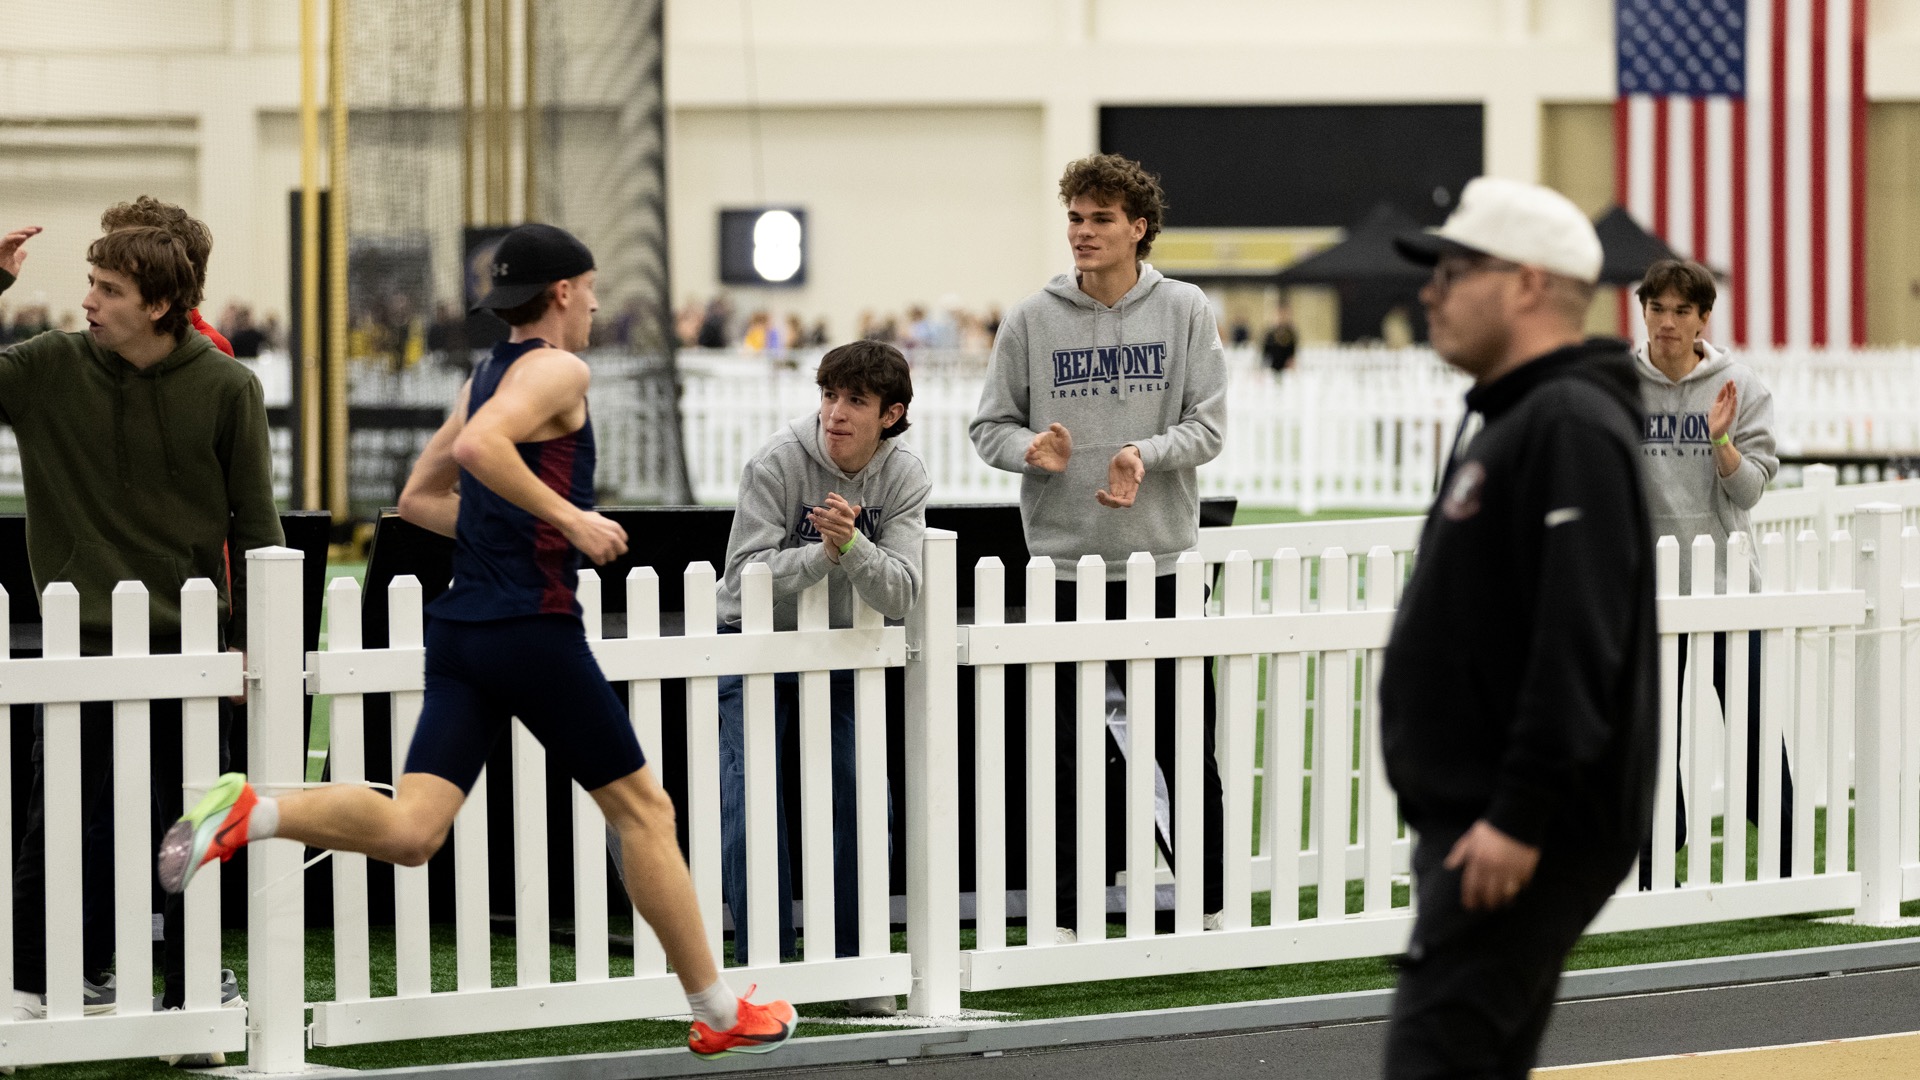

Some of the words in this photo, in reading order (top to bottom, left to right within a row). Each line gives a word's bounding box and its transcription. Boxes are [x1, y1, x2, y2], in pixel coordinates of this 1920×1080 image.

[1054, 342, 1166, 384] BELMONT
[1051, 387, 1099, 399] TRACK
[1110, 386, 1118, 395] &
[1129, 381, 1170, 393] FIELD
[1644, 413, 1710, 441] ELMON
[1643, 448, 1668, 457] ACK
